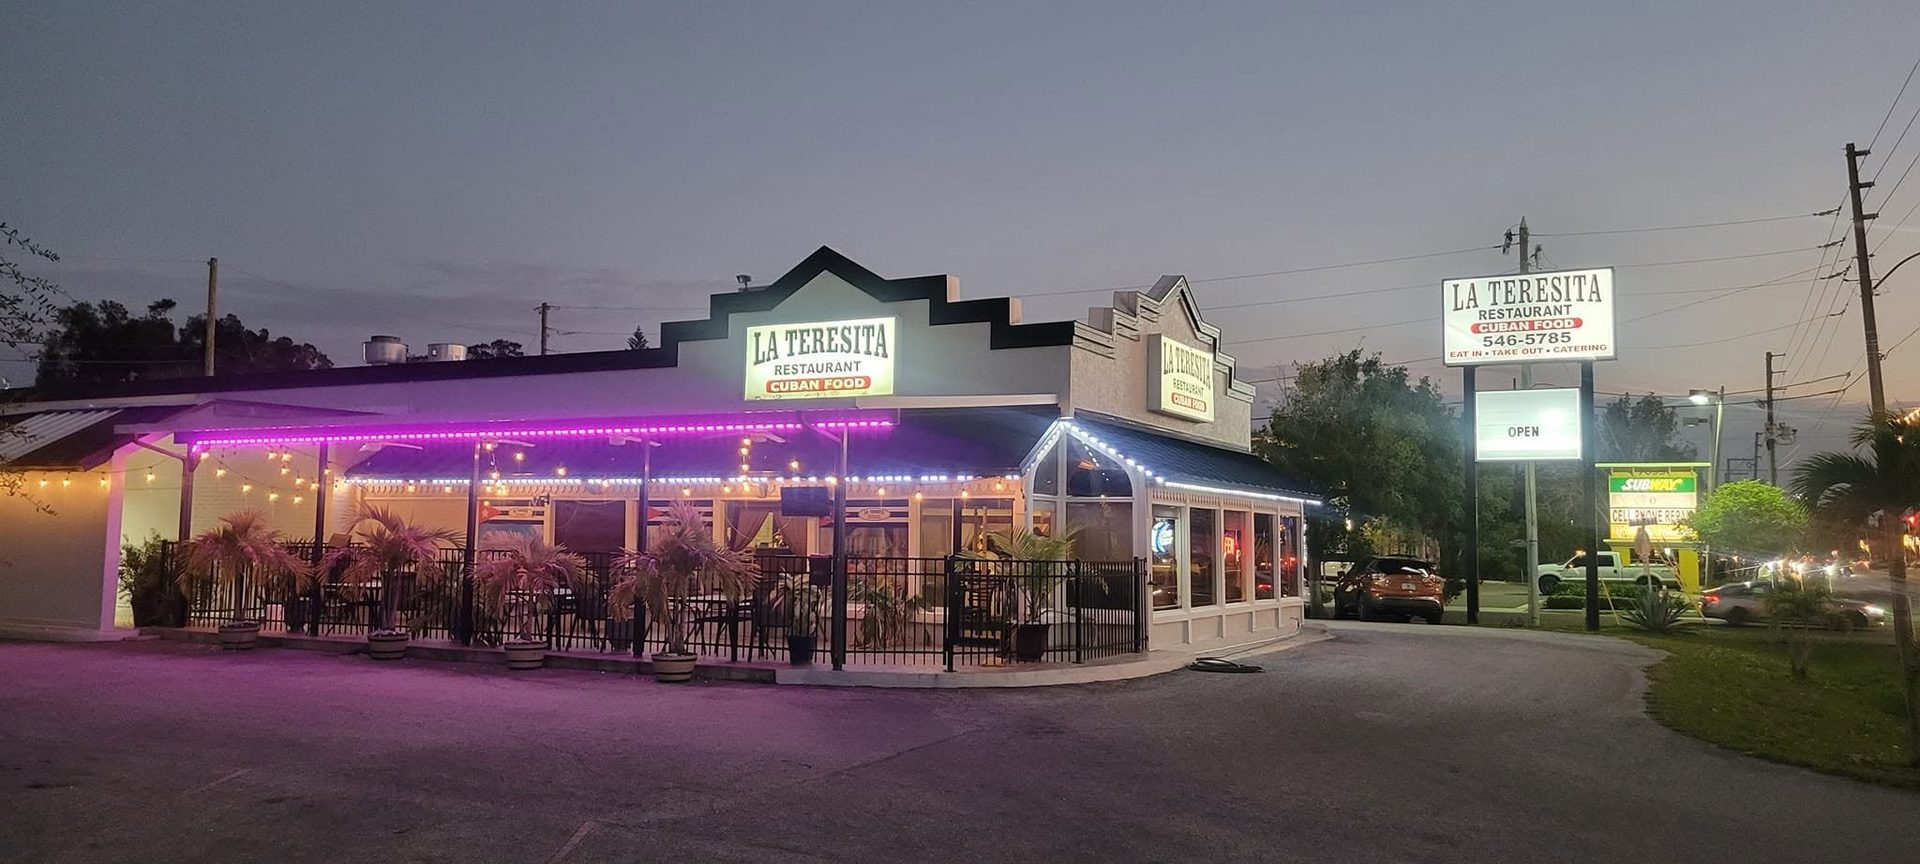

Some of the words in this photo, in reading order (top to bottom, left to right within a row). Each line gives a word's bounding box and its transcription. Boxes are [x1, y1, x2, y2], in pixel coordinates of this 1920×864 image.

[1452, 282, 1479, 312] LA
[1488, 274, 1602, 306] TERESITA
[1479, 304, 1572, 321] RESTAURANT
[1478, 321, 1529, 333] CUBAN
[1534, 318, 1575, 330] FOOD
[753, 331, 779, 366] LA
[785, 323, 888, 359] TERESITA
[1483, 332, 1572, 347] 546-5785
[1450, 350, 1469, 358] EAT
[1470, 350, 1482, 358] IN
[1492, 348, 1518, 357] TAKE
[1521, 347, 1544, 355] OUT
[1553, 343, 1608, 354] CATERING
[774, 360, 862, 376] RESTAURANT
[1163, 342, 1174, 375] LA
[1175, 346, 1211, 390] TERESITA
[770, 378, 820, 392] CUBAN
[823, 377, 865, 390] FOOD
[1508, 426, 1539, 437] OPEN
[1621, 478, 1684, 491] SUBWAY
